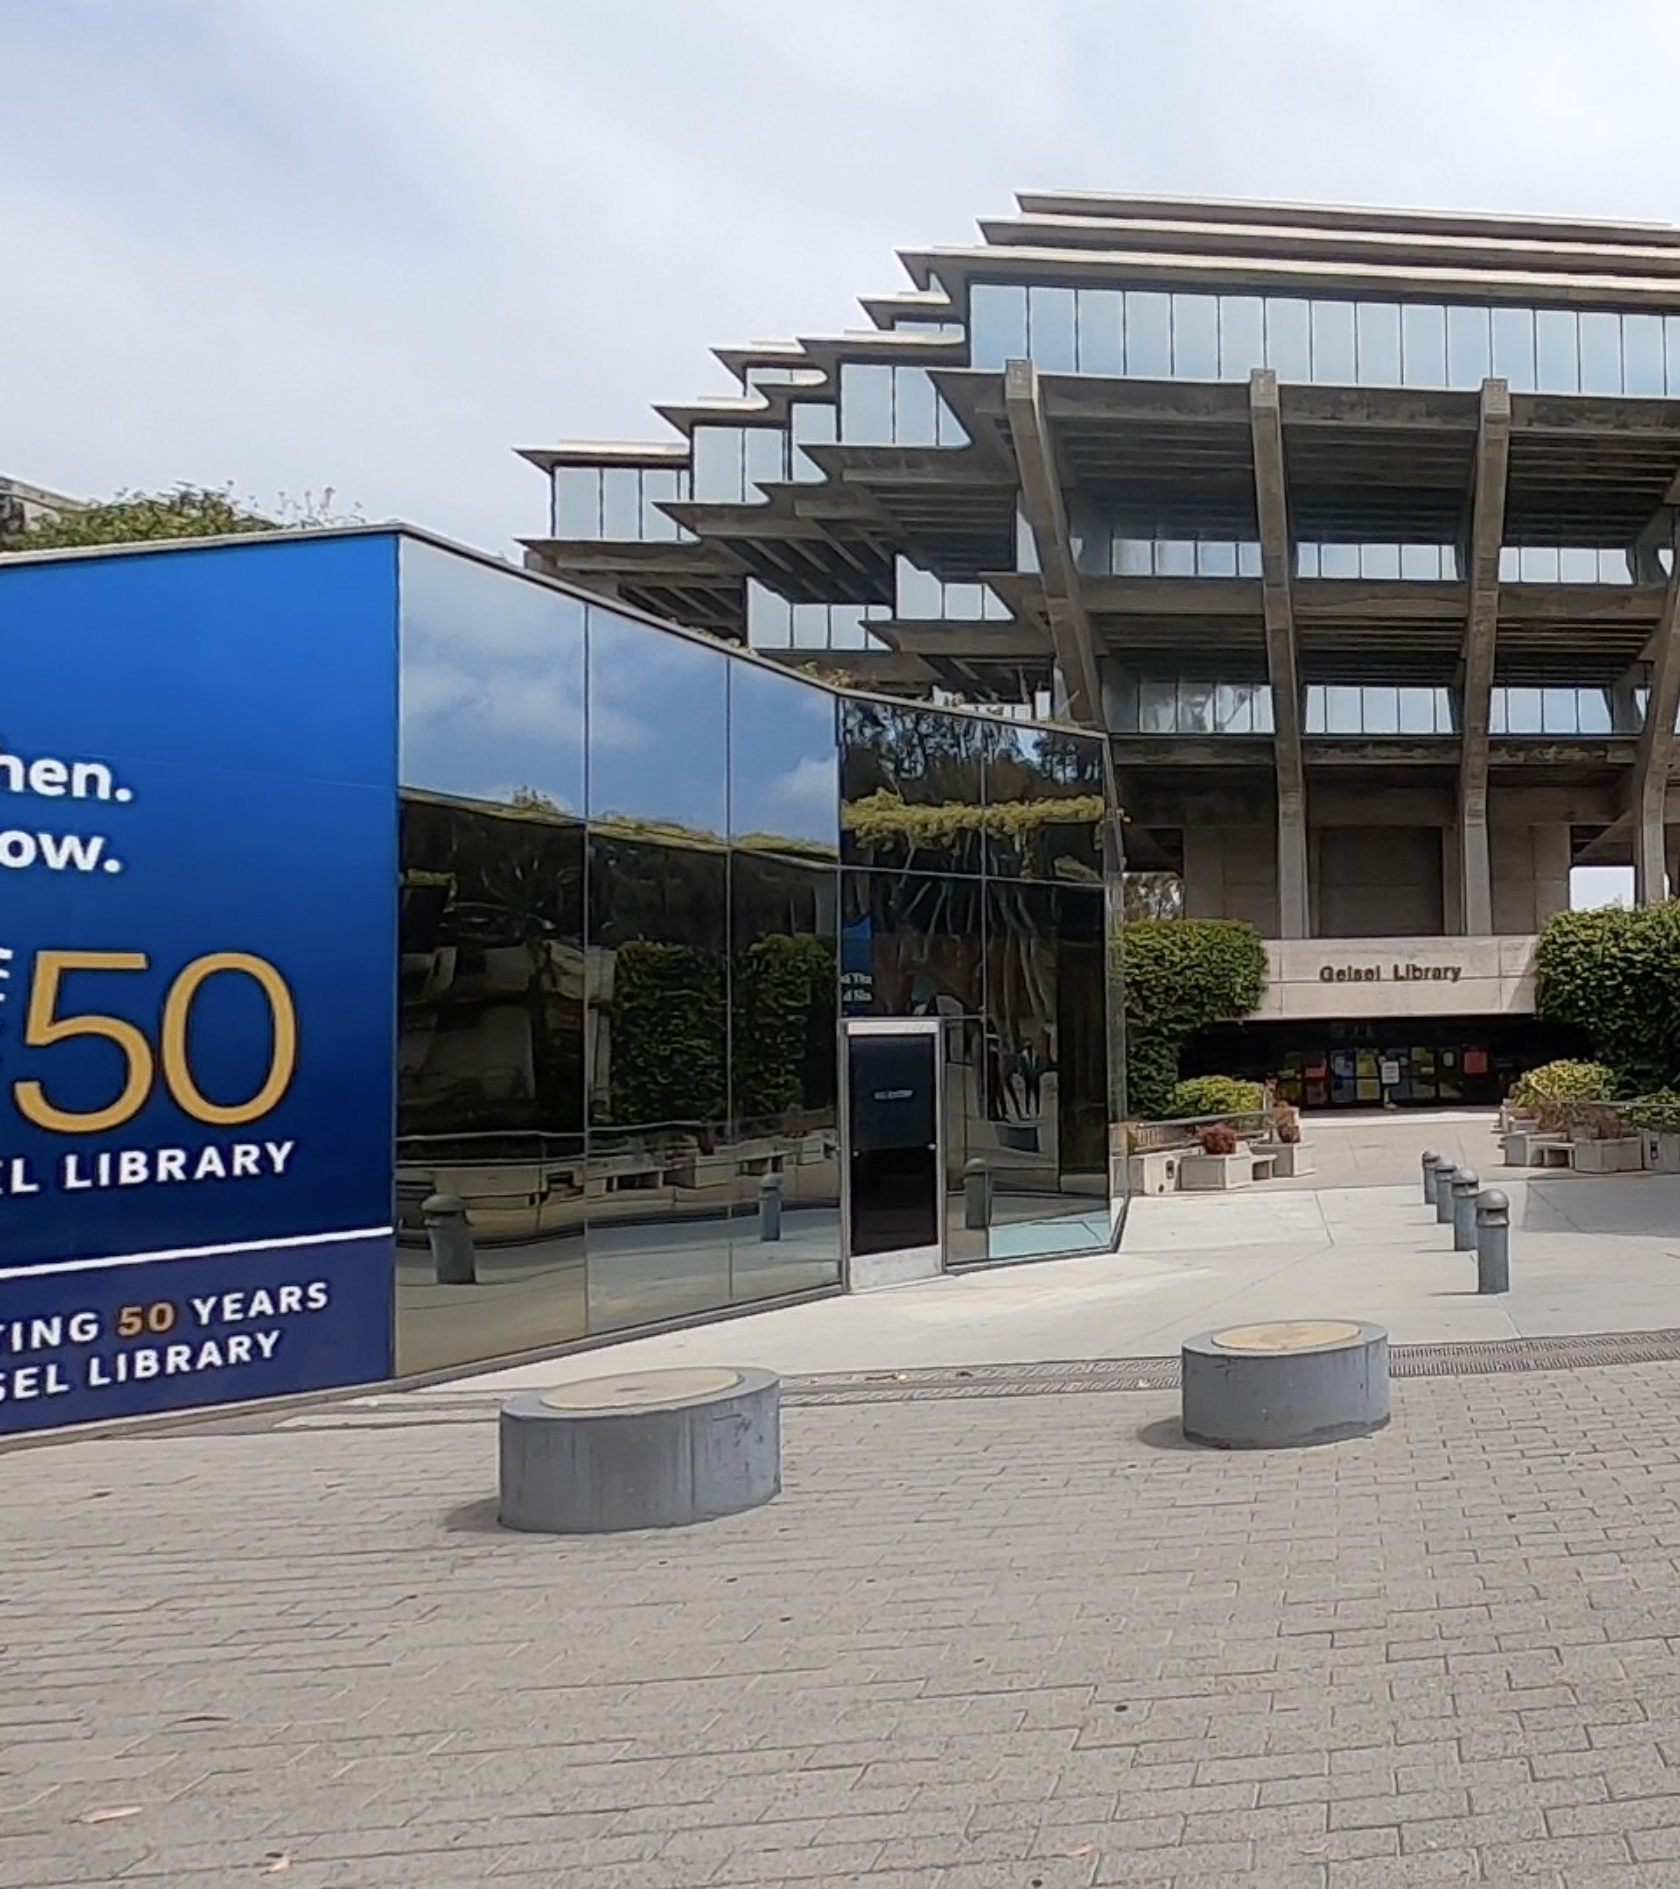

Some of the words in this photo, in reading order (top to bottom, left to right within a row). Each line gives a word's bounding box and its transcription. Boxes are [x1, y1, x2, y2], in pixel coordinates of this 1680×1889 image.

[1319, 965, 1381, 982] Geisel
[1393, 963, 1462, 983] Library
[13, 950, 297, 1133] 50
[0, 1158, 39, 1195] L
[64, 1140, 295, 1190] LIBRARY
[0, 1312, 99, 1352] ING
[117, 1301, 175, 1336] 50
[189, 1282, 328, 1326] YEARS
[89, 1330, 281, 1387] LIBRARY
